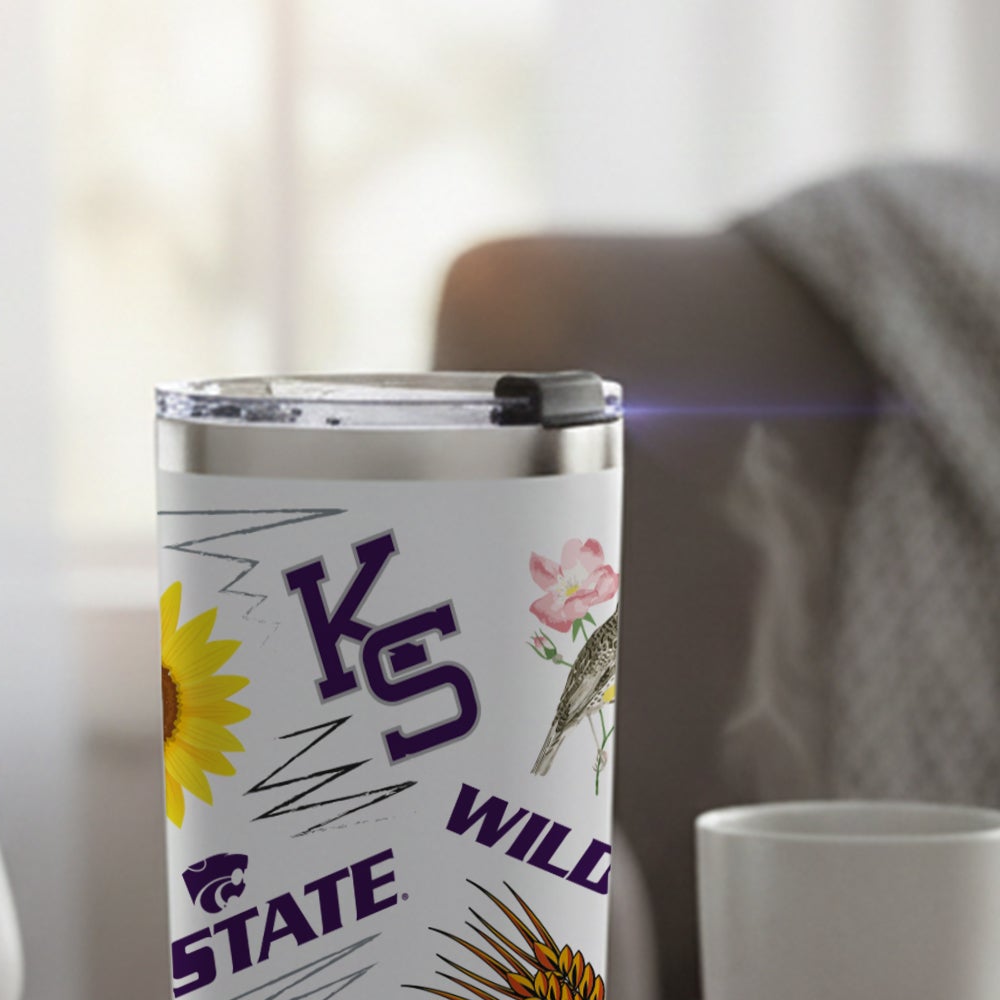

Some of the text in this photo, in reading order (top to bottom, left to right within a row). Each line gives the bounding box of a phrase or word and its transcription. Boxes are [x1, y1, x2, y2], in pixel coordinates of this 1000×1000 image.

[282, 529, 480, 765] KS
[446, 783, 612, 895] WILD
[171, 848, 398, 998] STATE
